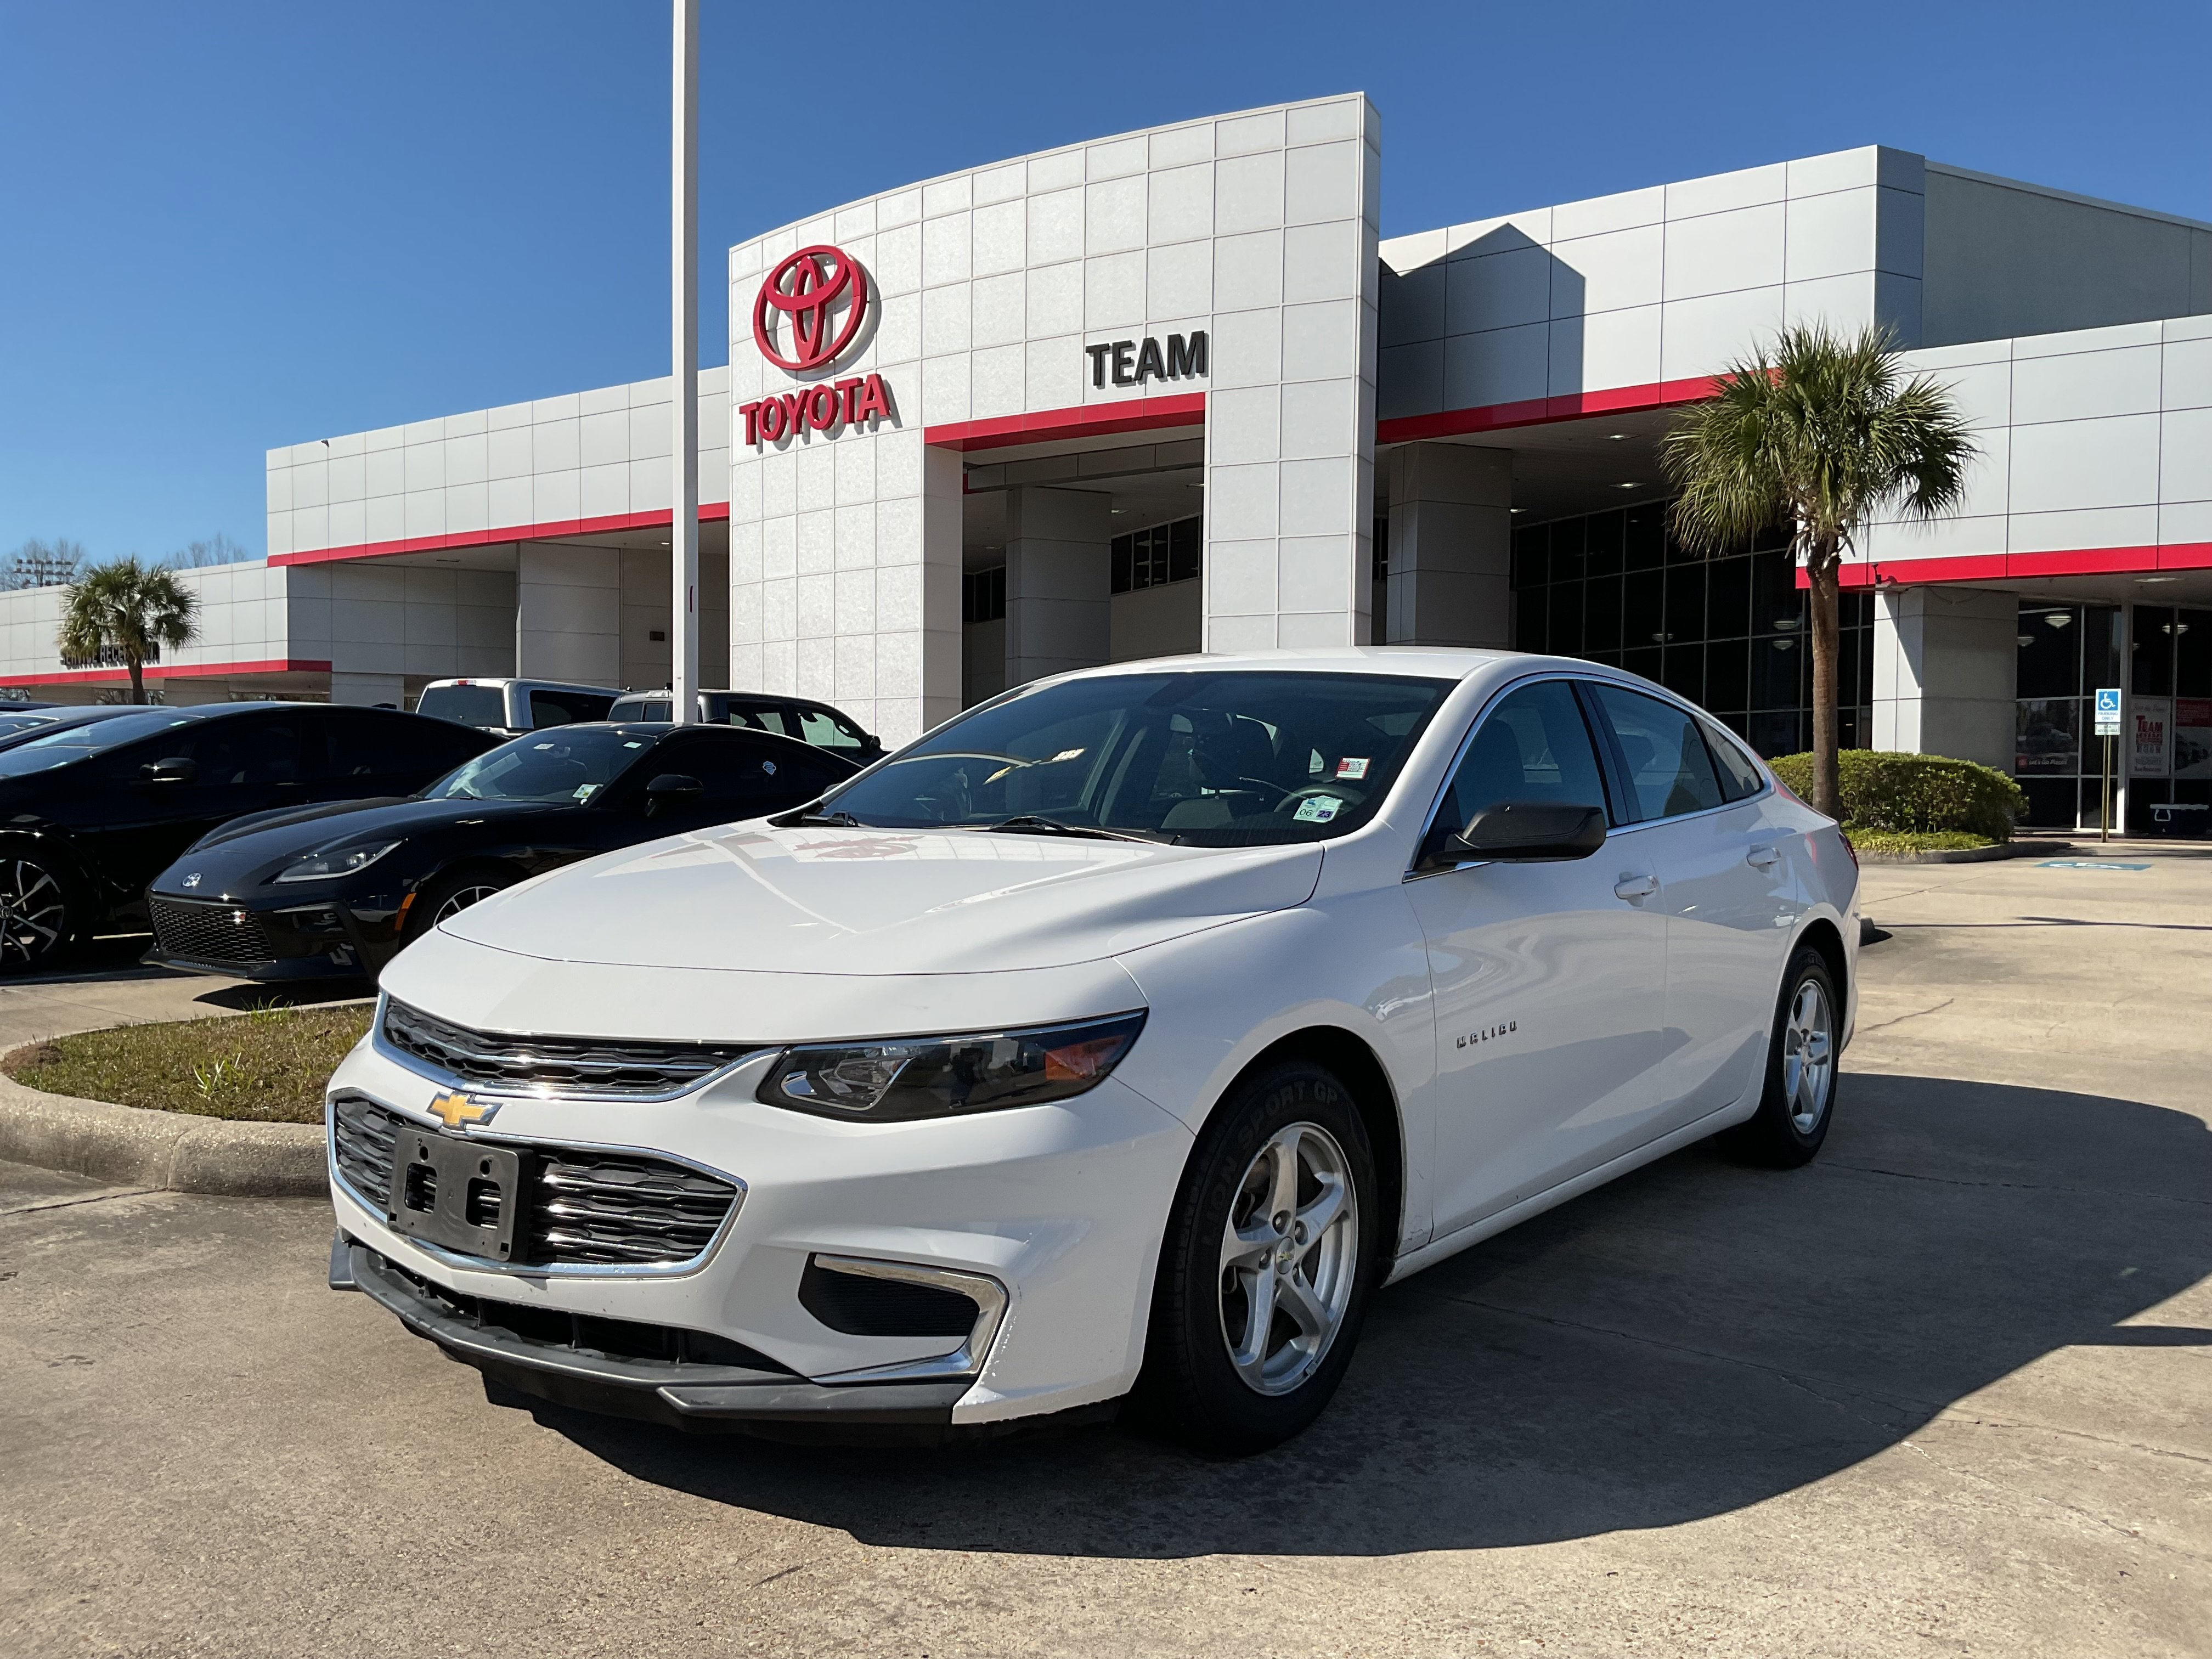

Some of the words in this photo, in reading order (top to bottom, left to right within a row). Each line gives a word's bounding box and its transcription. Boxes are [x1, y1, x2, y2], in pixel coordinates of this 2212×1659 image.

[1086, 330, 1205, 386] TEAM
[739, 373, 890, 445] TOYOTA
[2136, 715, 2163, 732] TEAM
[1457, 1020, 1517, 1048] MALIBU
